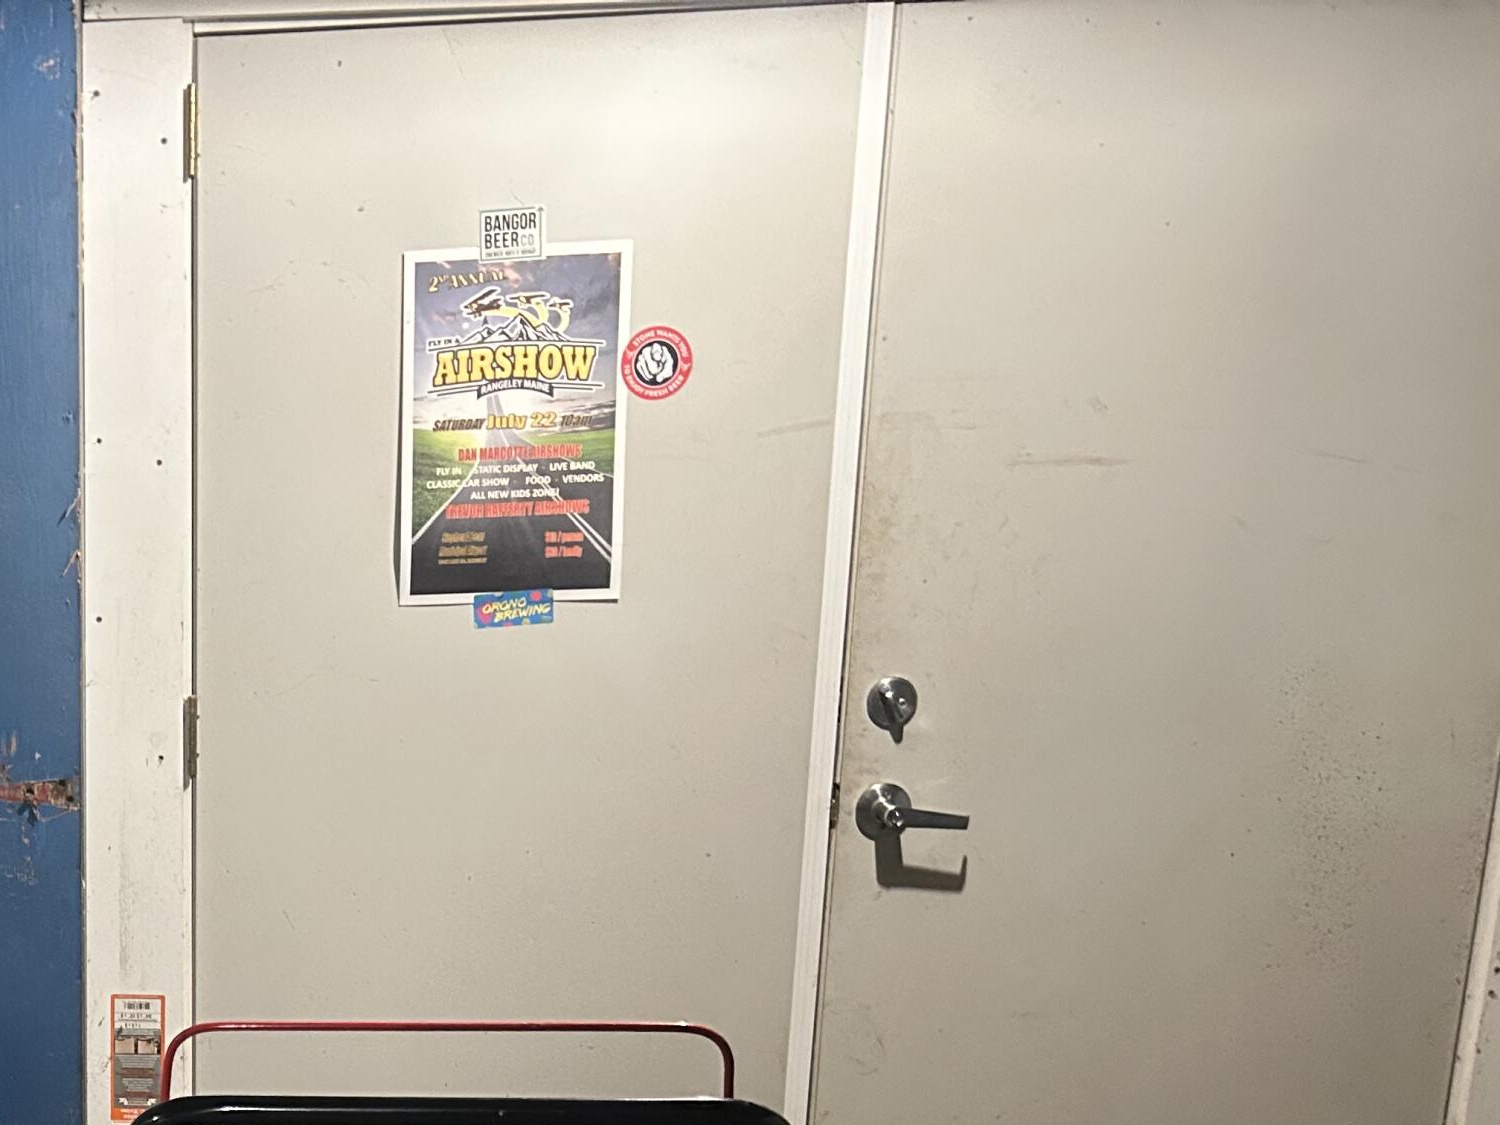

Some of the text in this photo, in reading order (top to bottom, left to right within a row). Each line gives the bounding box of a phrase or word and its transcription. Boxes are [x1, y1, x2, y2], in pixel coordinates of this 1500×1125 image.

[484, 211, 536, 232] BANGOR
[484, 231, 535, 249] BEER CO
[449, 270, 508, 289] ANNUAL
[433, 344, 596, 387] AIRSHOW
[481, 380, 550, 394] RANGELEY MAINE
[432, 418, 486, 432] SATURDAY
[486, 413, 527, 430] July
[531, 411, 557, 428] 22
[458, 447, 478, 462] DAN
[436, 460, 596, 476] FLY IN STATIC DISPLAY LIVE BAND
[426, 473, 605, 490] CLASSIC CAR SHOW FOOD VENDORS
[470, 491, 486, 500] ALL
[487, 489, 510, 499] NEW
[510, 488, 531, 498] KIDS
[481, 597, 527, 614] ORONO
[493, 602, 551, 623] BREWING
